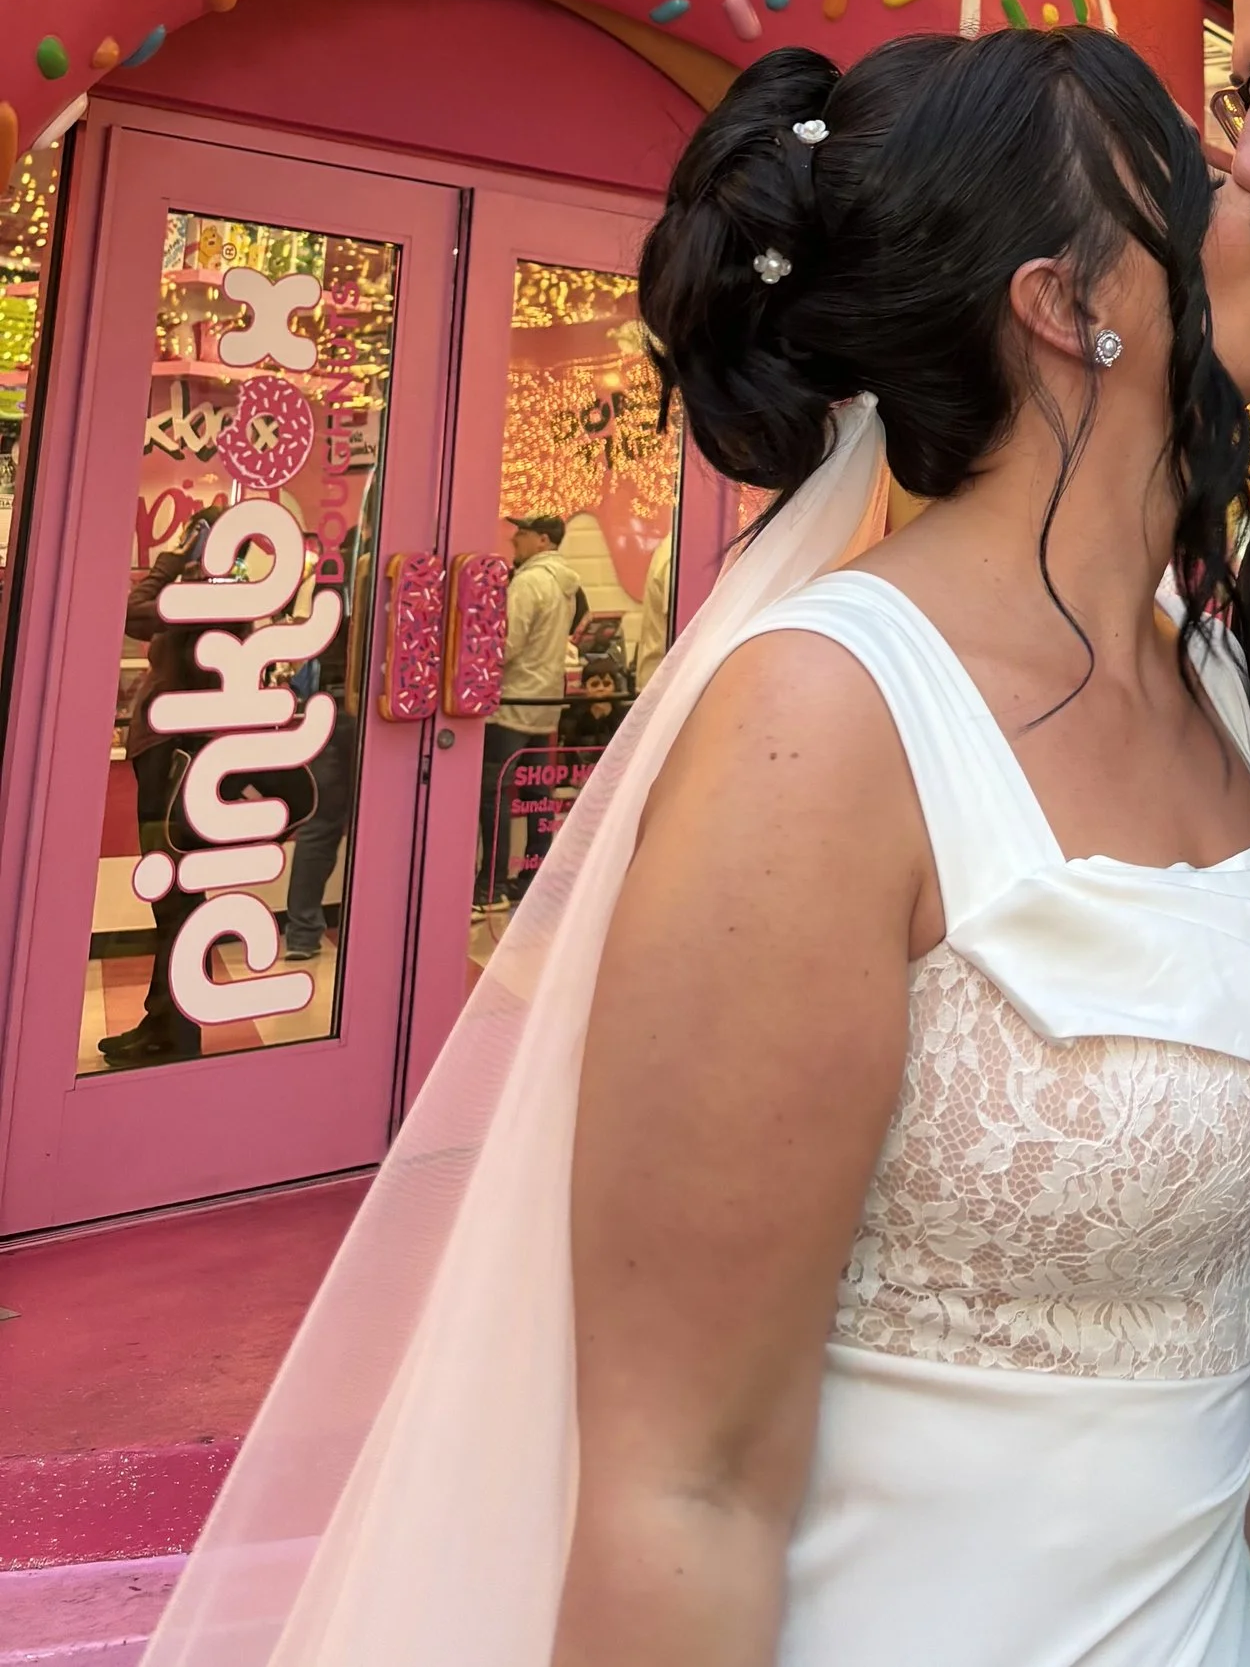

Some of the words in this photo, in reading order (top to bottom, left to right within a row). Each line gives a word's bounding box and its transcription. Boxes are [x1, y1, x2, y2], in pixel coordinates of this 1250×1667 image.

[315, 280, 361, 584] DOUGHNUTS
[514, 765, 569, 786] SHOP
[511, 796, 563, 815] Sunday
